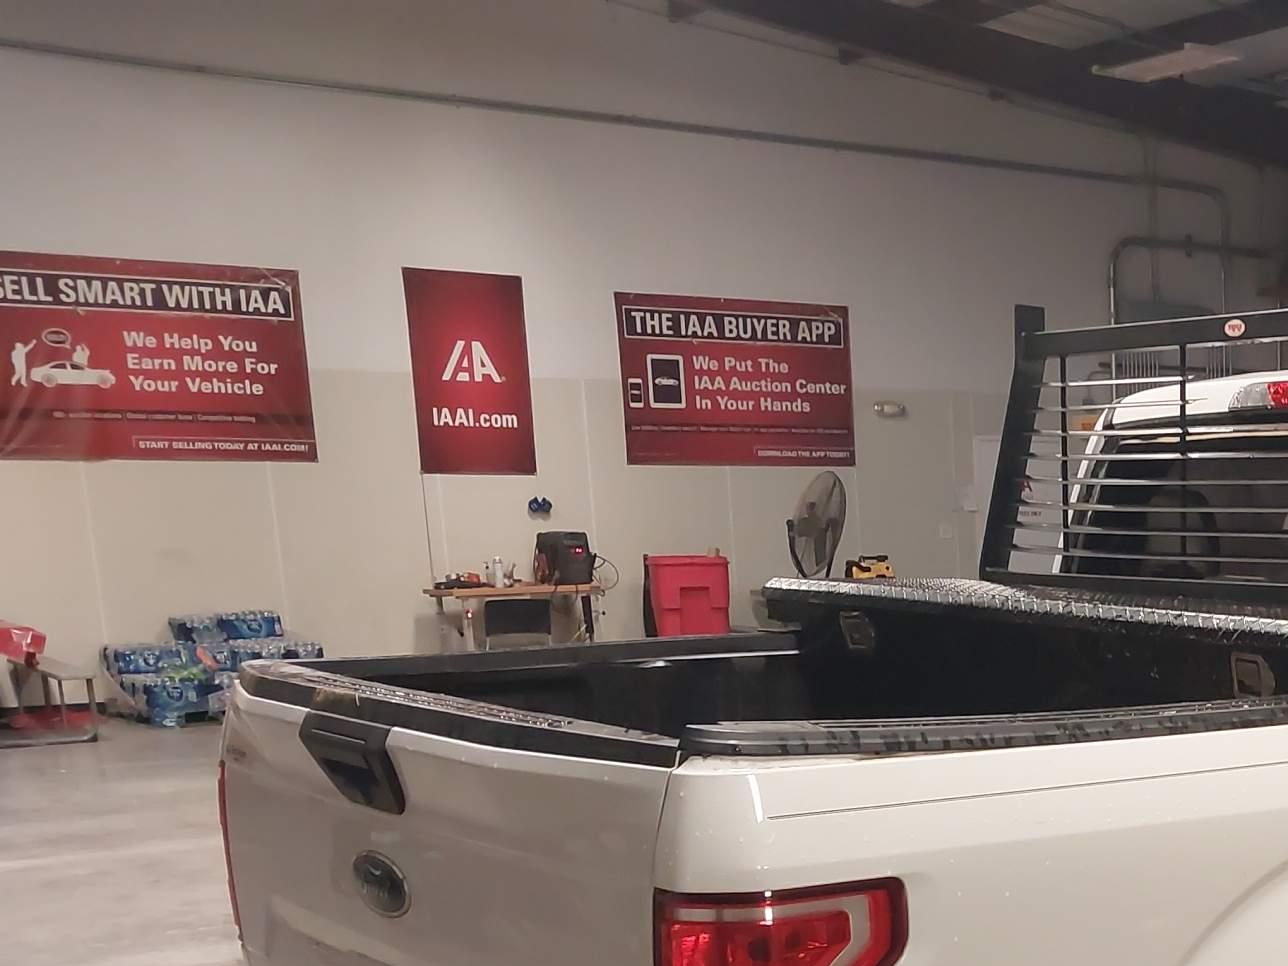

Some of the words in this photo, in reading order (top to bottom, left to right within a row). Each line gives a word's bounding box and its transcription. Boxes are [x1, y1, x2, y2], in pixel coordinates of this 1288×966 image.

[58, 278, 156, 307] SMART
[162, 284, 232, 311] WITH
[240, 289, 286, 314] IAA
[631, 311, 674, 335] THE
[680, 314, 718, 337] IAA
[724, 316, 791, 341] BUYER
[797, 320, 836, 343] APP
[123, 331, 158, 348] We
[164, 333, 213, 353] Help
[219, 335, 257, 352] You
[127, 354, 176, 371] Earn
[182, 356, 238, 373] More
[245, 358, 278, 374] For
[692, 355, 718, 371] We
[724, 357, 752, 372] Put
[758, 358, 788, 373] The
[129, 376, 178, 392] Your
[186, 377, 264, 395] Vehicle
[694, 375, 725, 390] IAA
[729, 377, 791, 393] Auction
[795, 378, 847, 395] Center
[695, 395, 711, 410] In
[716, 396, 754, 411] Your
[759, 397, 811, 412] Hands
[432, 407, 518, 428] IAAI.com
[139, 440, 168, 450] START
[173, 441, 212, 450] SELLING
[214, 442, 244, 451] TODAY
[247, 443, 258, 451] AT
